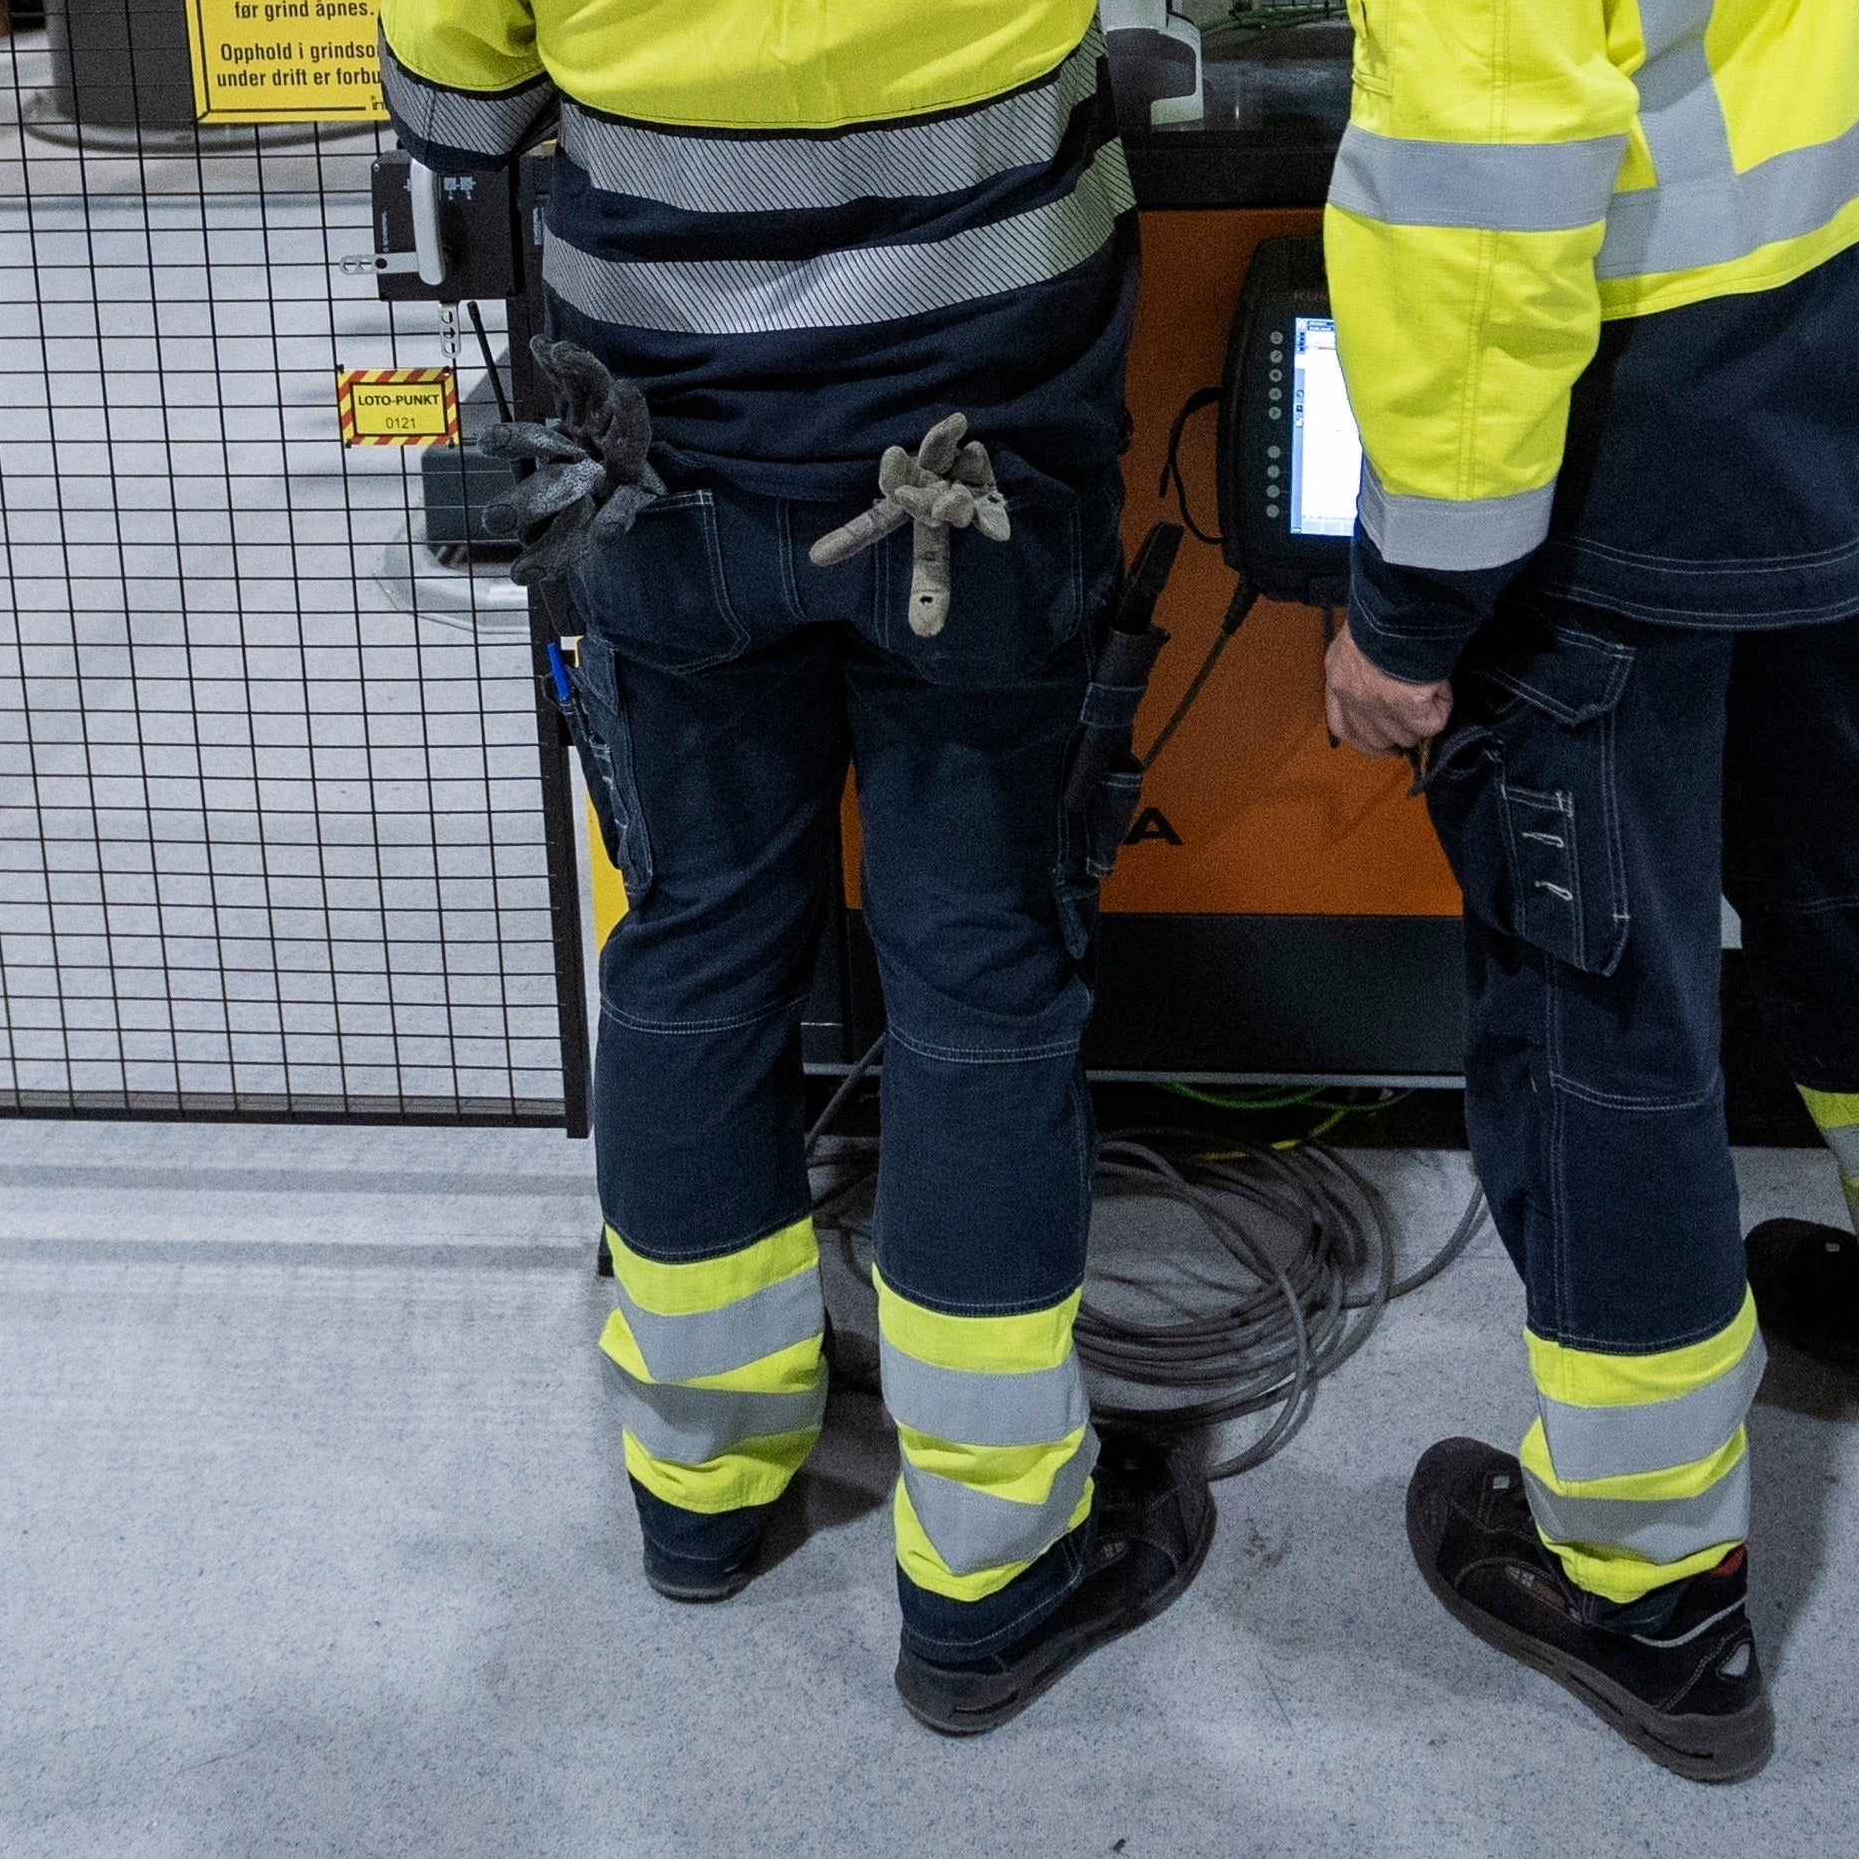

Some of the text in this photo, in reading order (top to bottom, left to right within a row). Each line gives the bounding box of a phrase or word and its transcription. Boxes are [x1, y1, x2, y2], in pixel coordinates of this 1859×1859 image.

[234, 0, 259, 19] før
[264, 0, 310, 22] grind
[220, 40, 380, 65] Opphold i grindso
[217, 68, 267, 87] under
[272, 68, 308, 87] drift
[313, 71, 332, 86] er
[357, 393, 440, 407] LOTO-PUNKT
[385, 416, 417, 430] 0121
